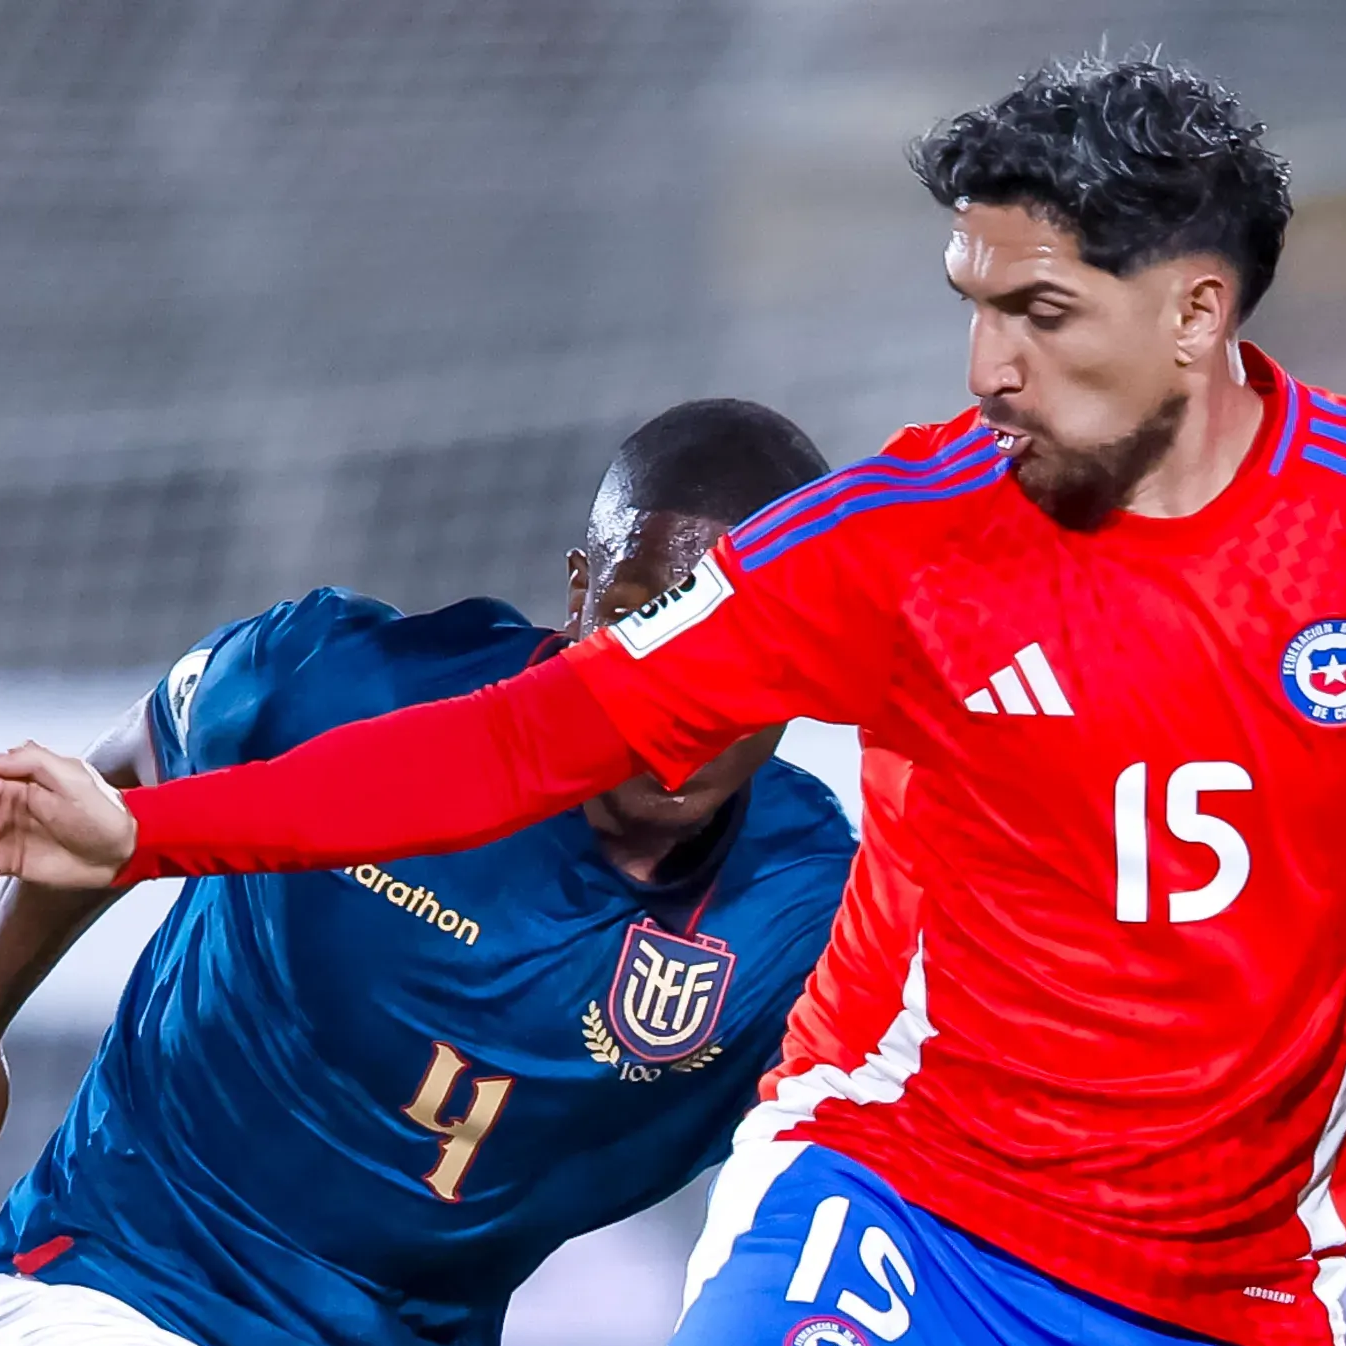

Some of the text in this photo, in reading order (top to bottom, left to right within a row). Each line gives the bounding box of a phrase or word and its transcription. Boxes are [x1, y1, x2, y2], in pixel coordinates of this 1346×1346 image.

[343, 863, 480, 946] arathon
[1114, 760, 1253, 923] 15
[401, 1041, 515, 1202] 4
[619, 1061, 662, 1082] 100
[785, 1195, 917, 1342] 15
